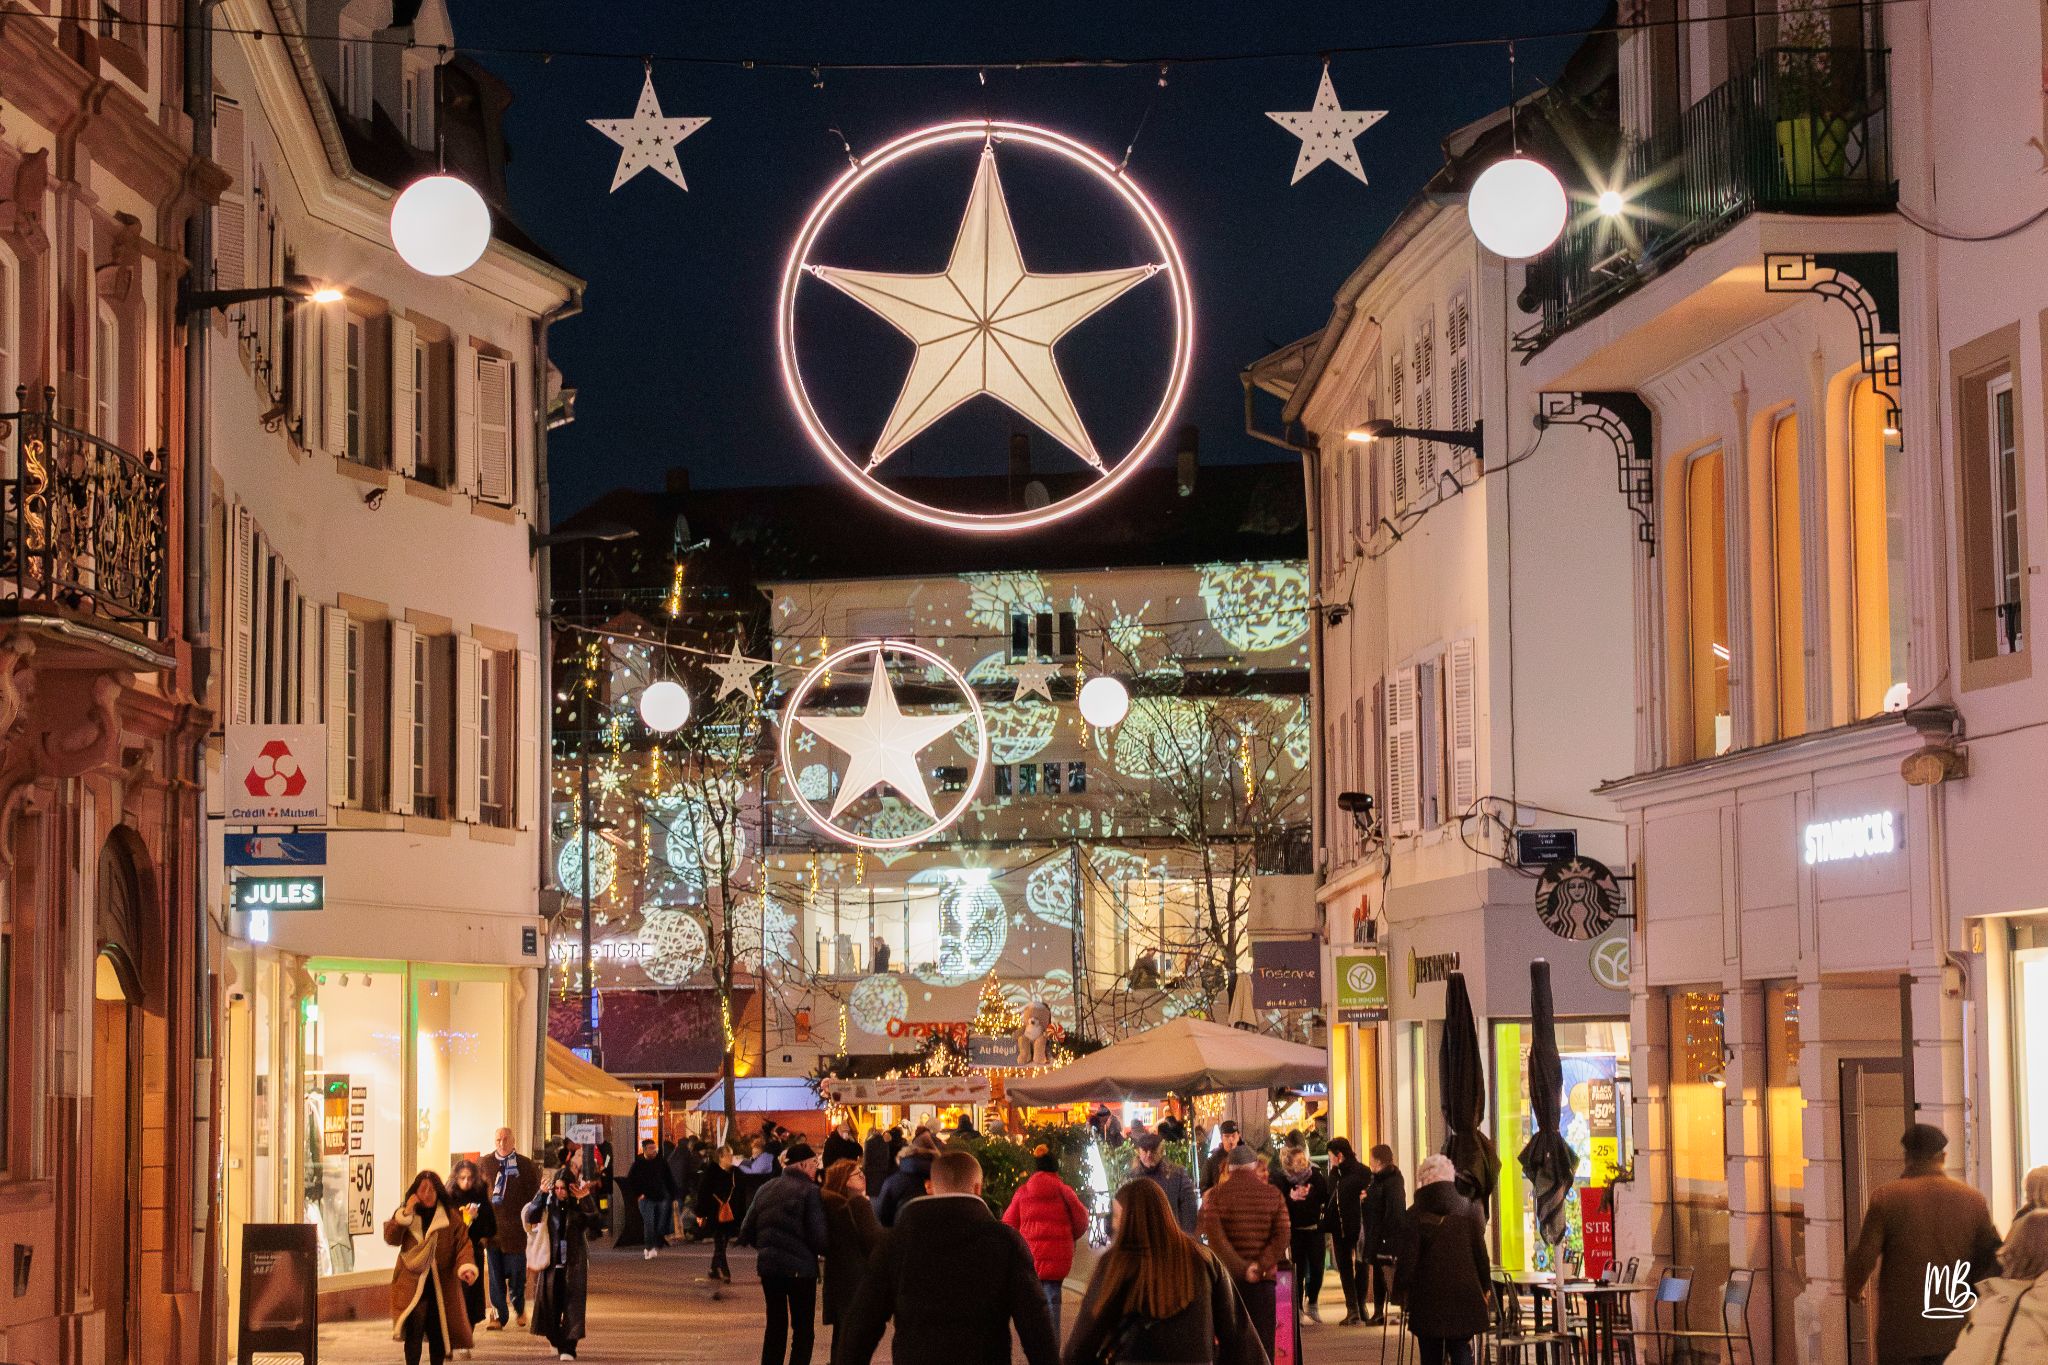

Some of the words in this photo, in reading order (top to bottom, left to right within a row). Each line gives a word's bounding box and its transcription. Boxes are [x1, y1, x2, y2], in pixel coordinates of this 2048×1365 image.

[232, 808, 265, 818] Crédit
[280, 808, 318, 818] Mutuel
[244, 883, 316, 904] JULES
[602, 943, 652, 959] TIGRE
[1592, 1085, 1612, 1094] BLACK
[1592, 1092, 1612, 1101] FRIDAY
[1590, 1103, 1616, 1118] -50%
[325, 1115, 346, 1131] BLACK
[325, 1132, 346, 1147] WEEK
[1593, 1145, 1615, 1157] -25%
[351, 1162, 373, 1193] -50
[360, 1198, 372, 1228] %
